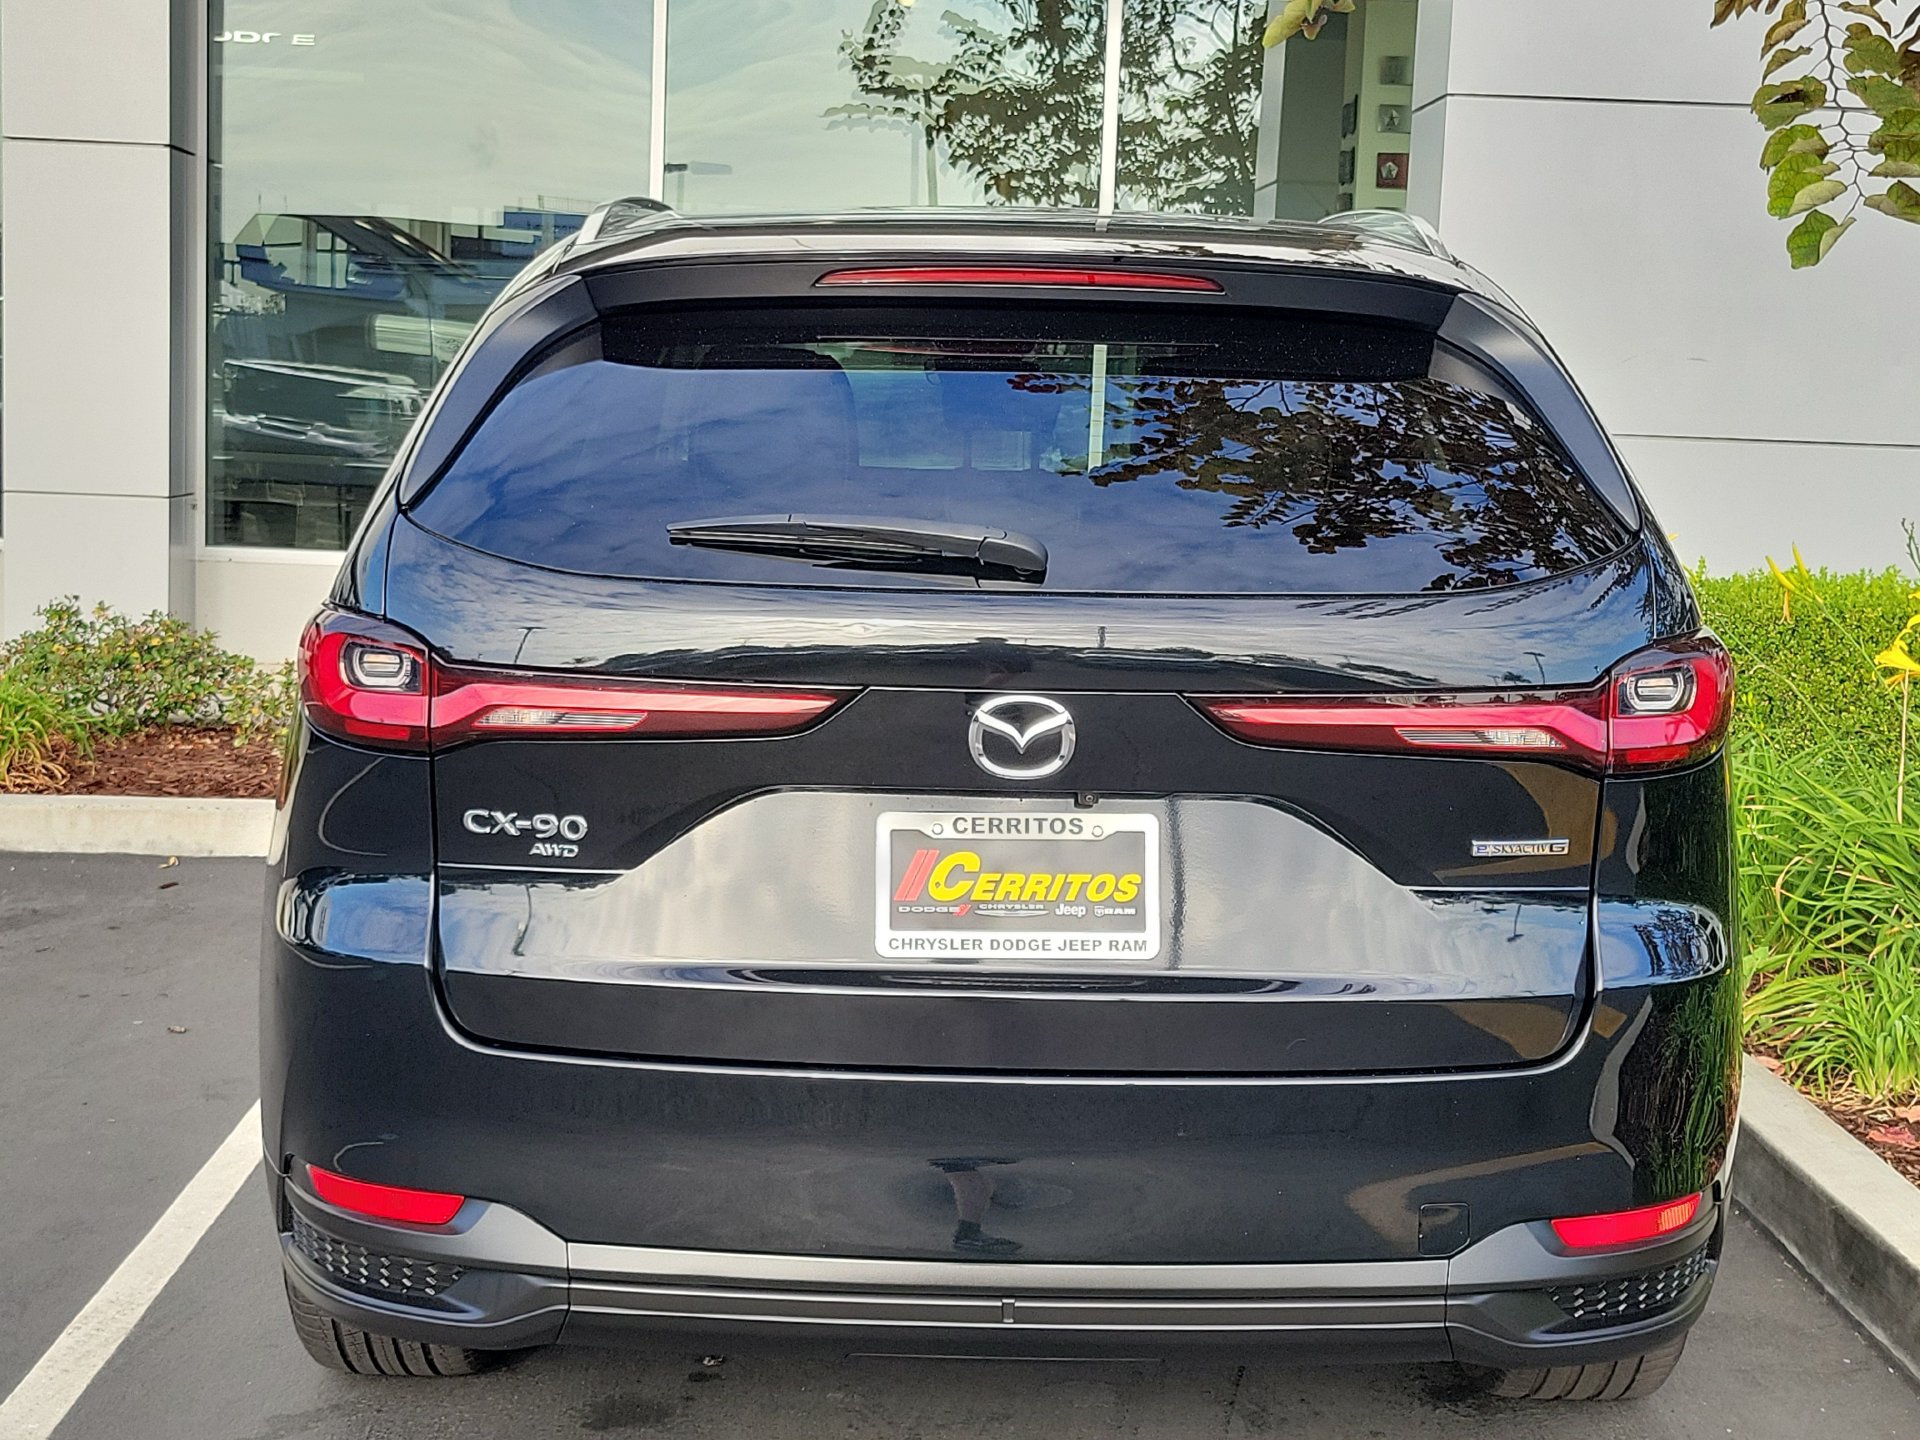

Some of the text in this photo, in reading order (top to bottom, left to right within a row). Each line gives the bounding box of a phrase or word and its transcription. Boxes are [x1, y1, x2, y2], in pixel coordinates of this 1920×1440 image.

[463, 808, 588, 841] CX-90
[952, 817, 1084, 835] CERRITOS
[528, 842, 579, 857] AWD
[898, 905, 960, 914] DODGE
[1055, 904, 1087, 918] Jeep
[1104, 907, 1136, 915] RAM
[888, 938, 1148, 952] CHRYSLER DODGE JEEP RAM
